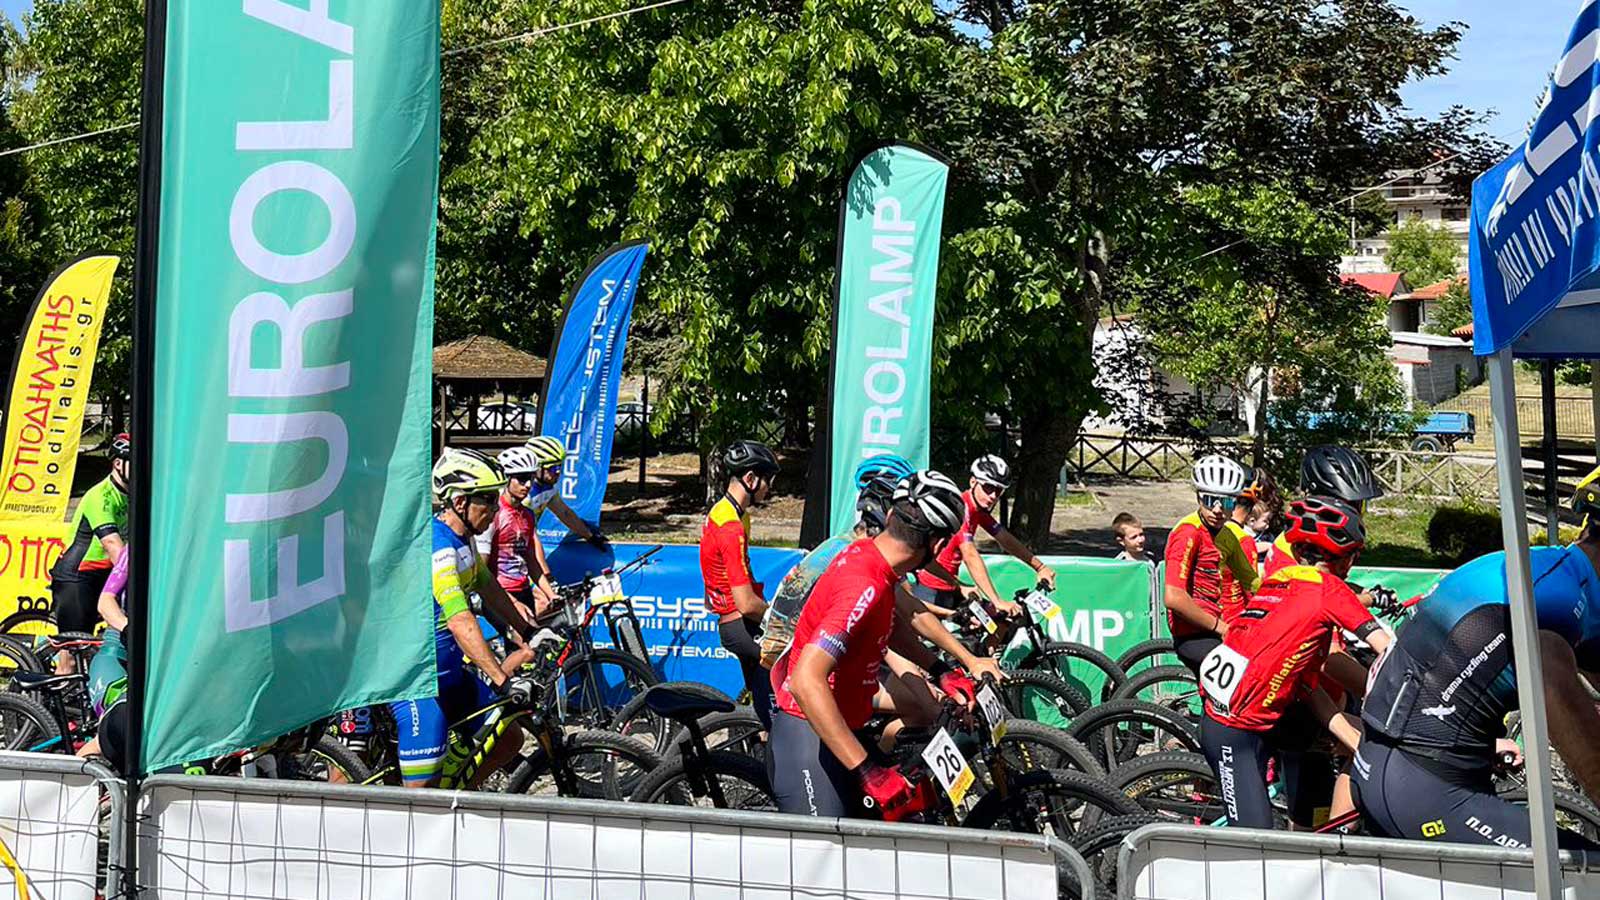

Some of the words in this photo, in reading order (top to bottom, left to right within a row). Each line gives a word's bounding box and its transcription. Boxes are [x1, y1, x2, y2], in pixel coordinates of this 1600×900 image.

[43, 296, 94, 496] podilatis.gr
[1034, 596, 1051, 611] 25
[1204, 654, 1235, 689] 20
[1441, 677, 1463, 703] drama
[1460, 650, 1489, 680] cycling
[1485, 632, 1506, 655] team
[935, 744, 961, 782] 26
